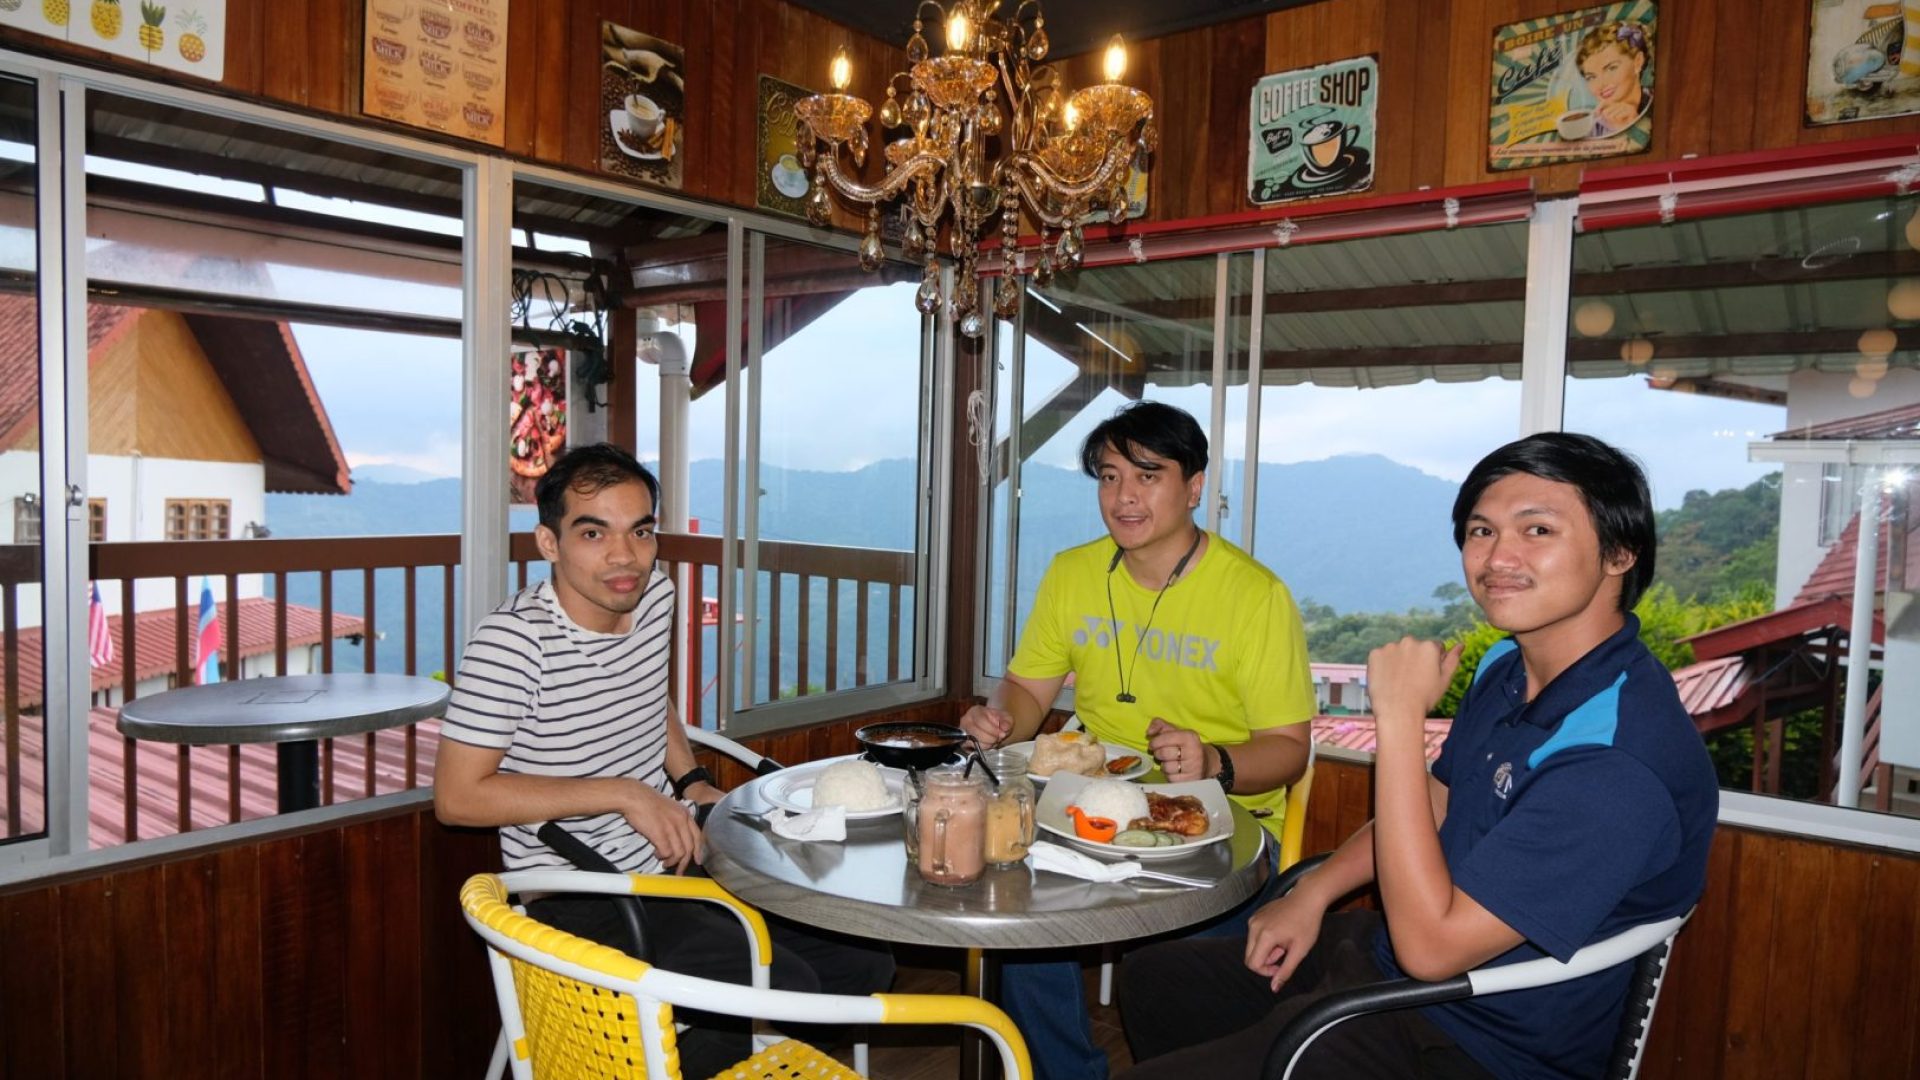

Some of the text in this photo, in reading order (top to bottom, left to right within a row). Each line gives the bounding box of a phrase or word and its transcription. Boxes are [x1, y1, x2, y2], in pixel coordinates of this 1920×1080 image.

[1259, 67, 1369, 126] COFFEE SHOP
[1134, 624, 1219, 671] YONEX
